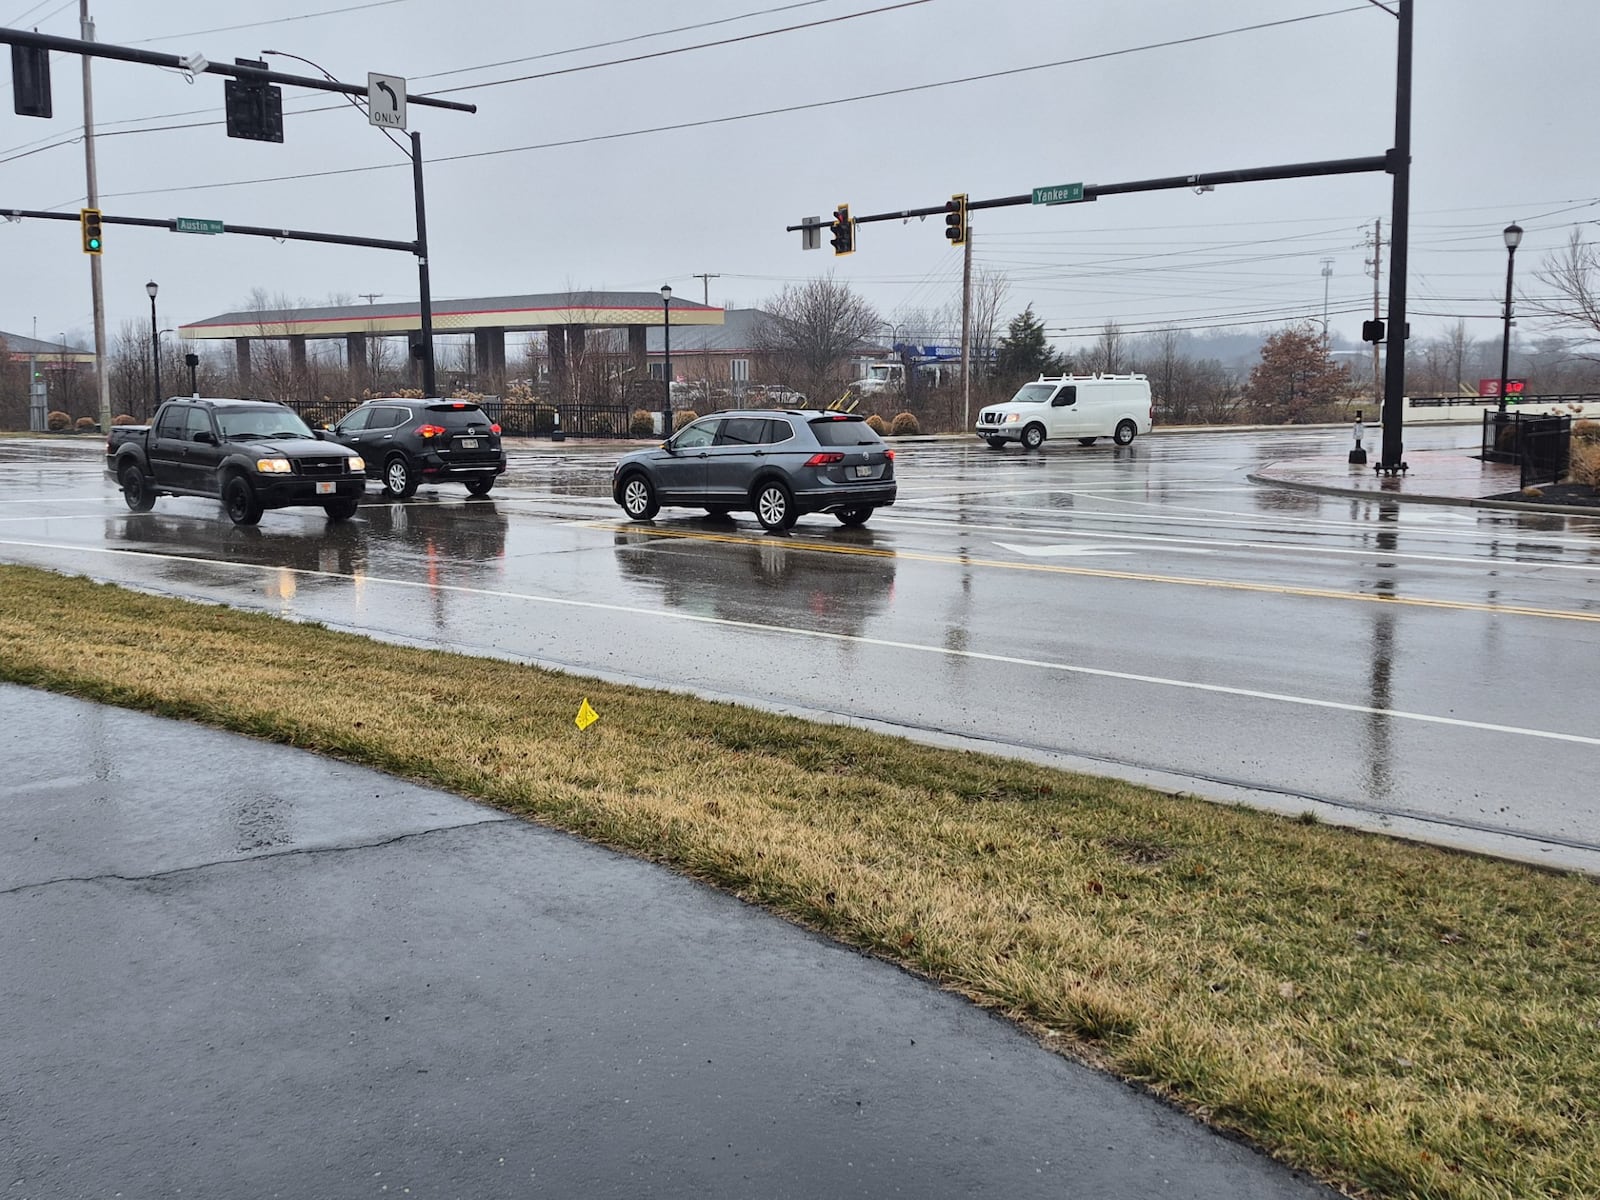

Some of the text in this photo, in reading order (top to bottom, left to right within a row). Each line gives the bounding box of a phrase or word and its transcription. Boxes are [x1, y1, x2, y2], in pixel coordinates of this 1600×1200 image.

[374, 111, 401, 125] ONLY
[1036, 189, 1069, 202] Yankee
[180, 220, 209, 231] Austin
